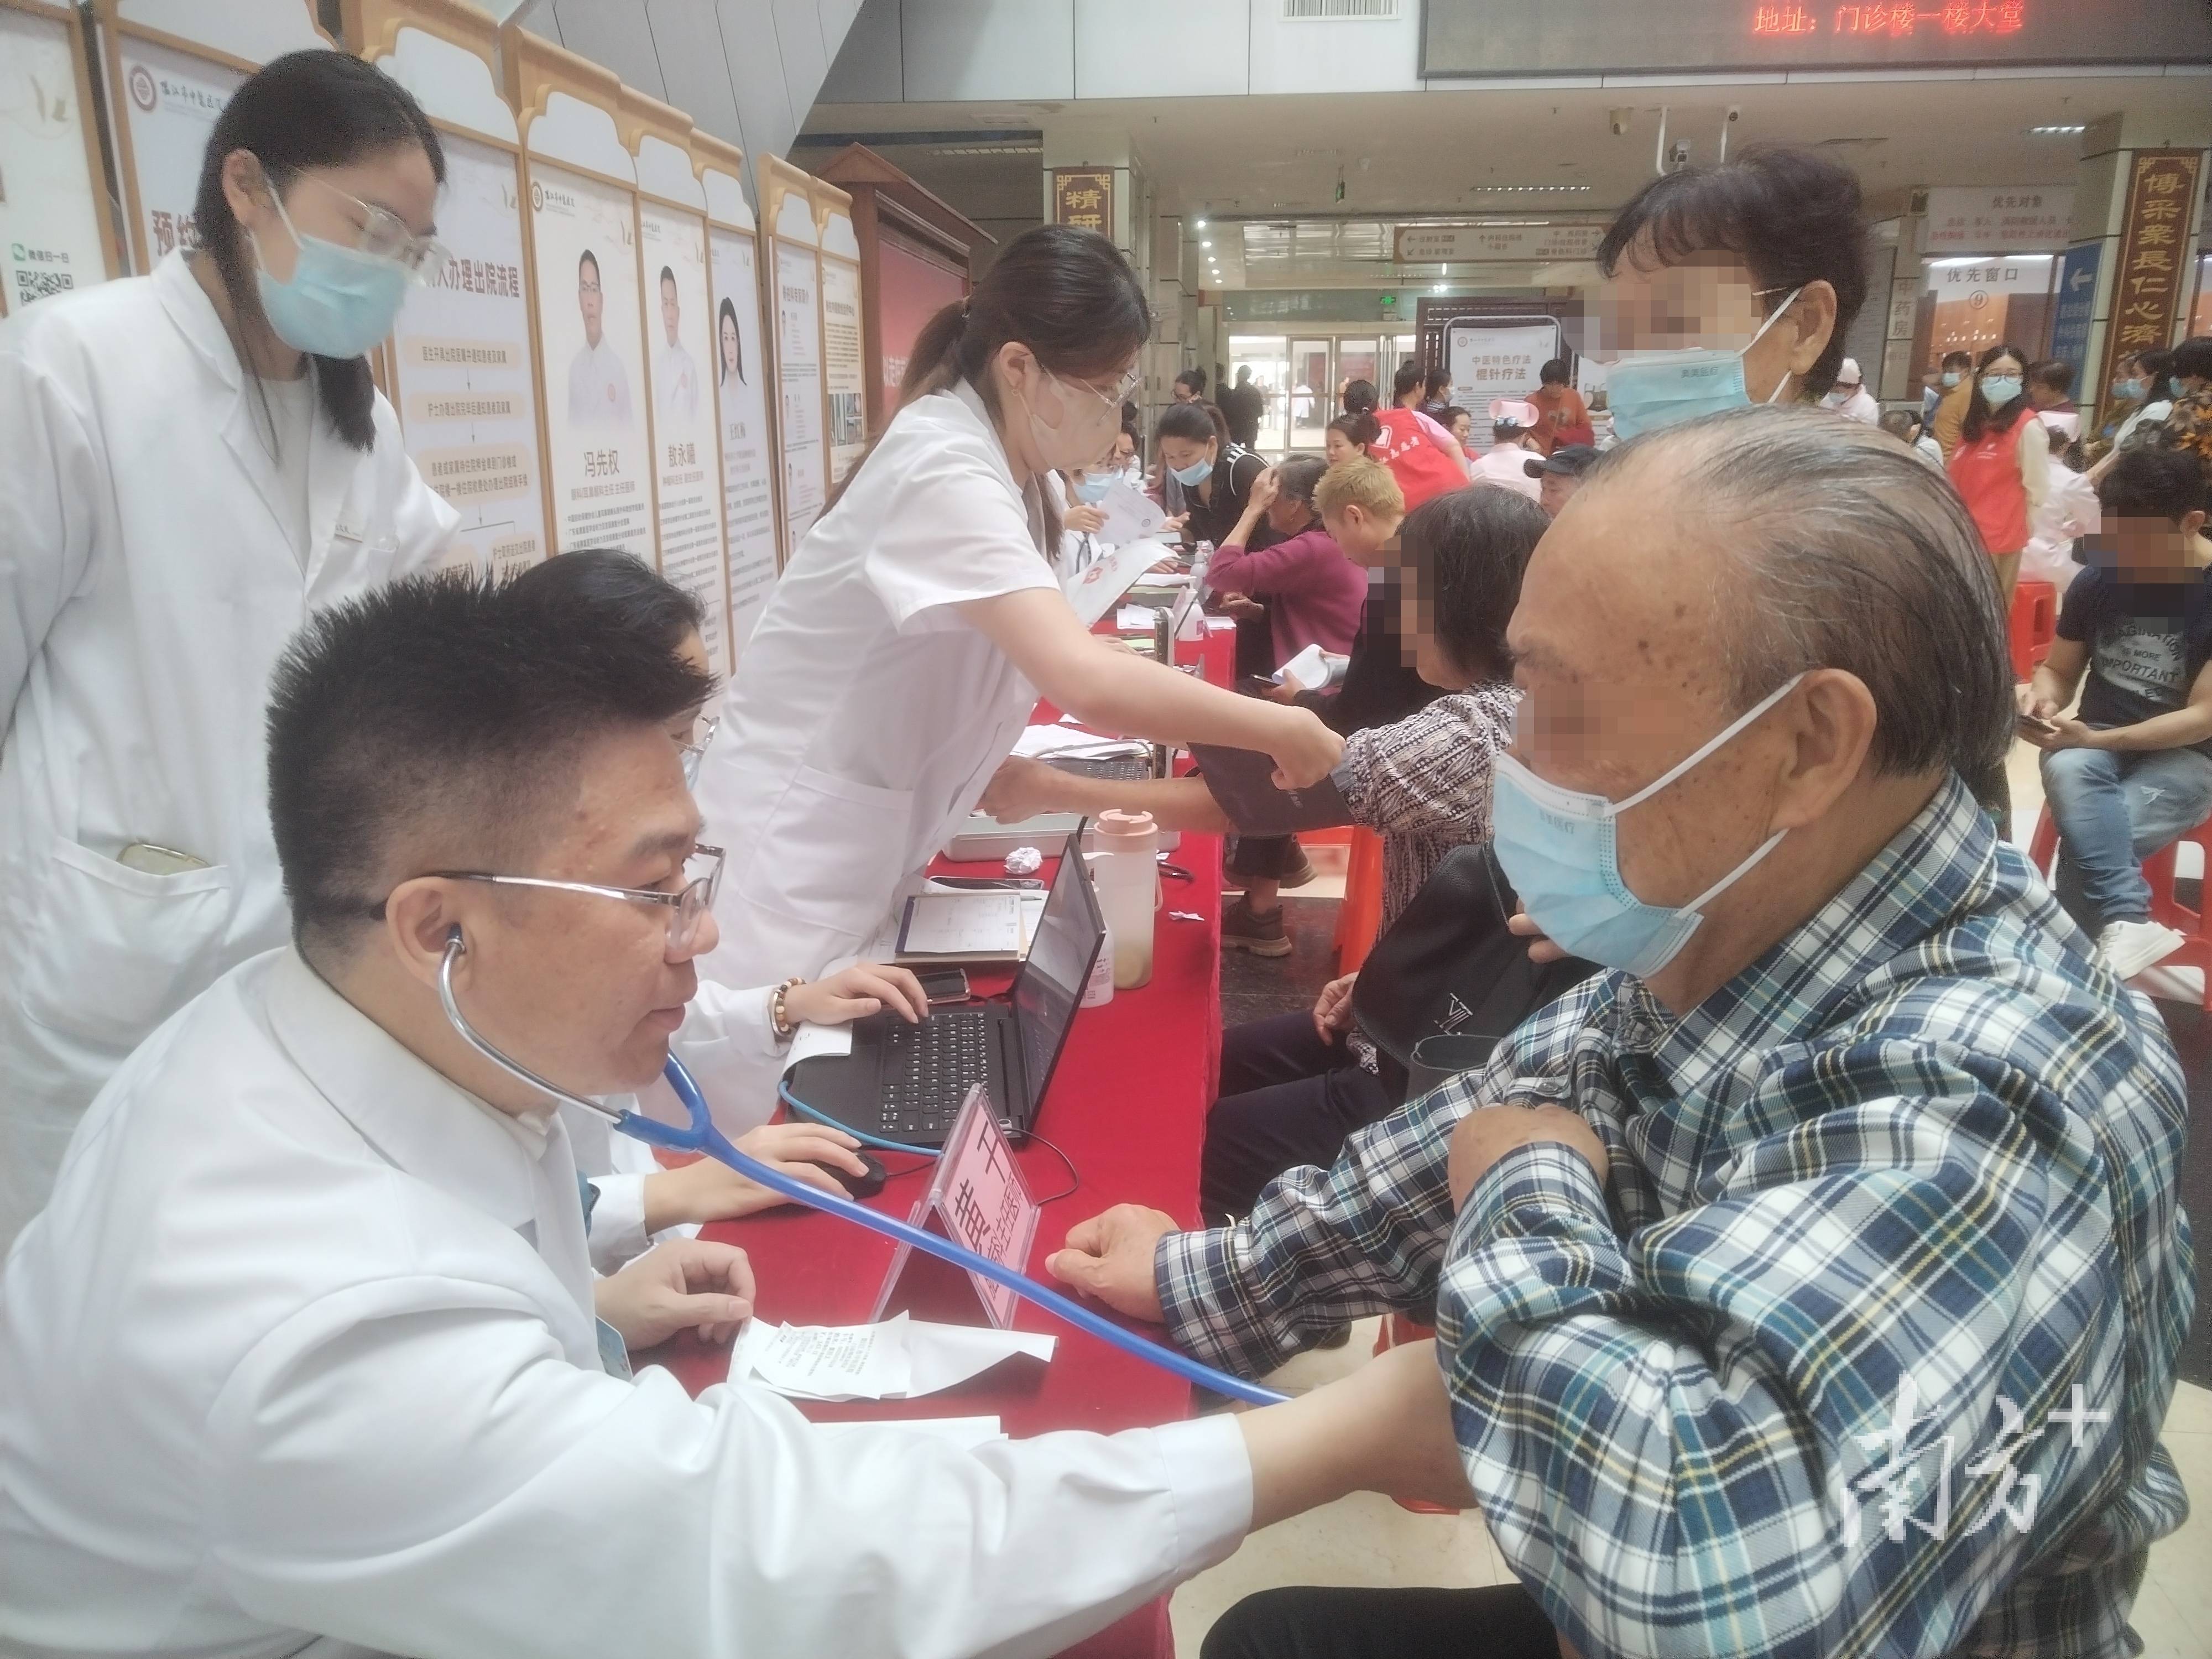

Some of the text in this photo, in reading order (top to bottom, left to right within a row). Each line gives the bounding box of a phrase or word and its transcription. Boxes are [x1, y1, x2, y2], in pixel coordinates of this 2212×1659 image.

[1947, 268, 2018, 283] 优先窗口
[1893, 282, 1913, 336] 中药房
[1472, 355, 1531, 365] 中医特色疗法
[584, 449, 620, 478] 冯先权
[2133, 649, 2161, 661] MORE
[955, 1178, 990, 1256] 黄
